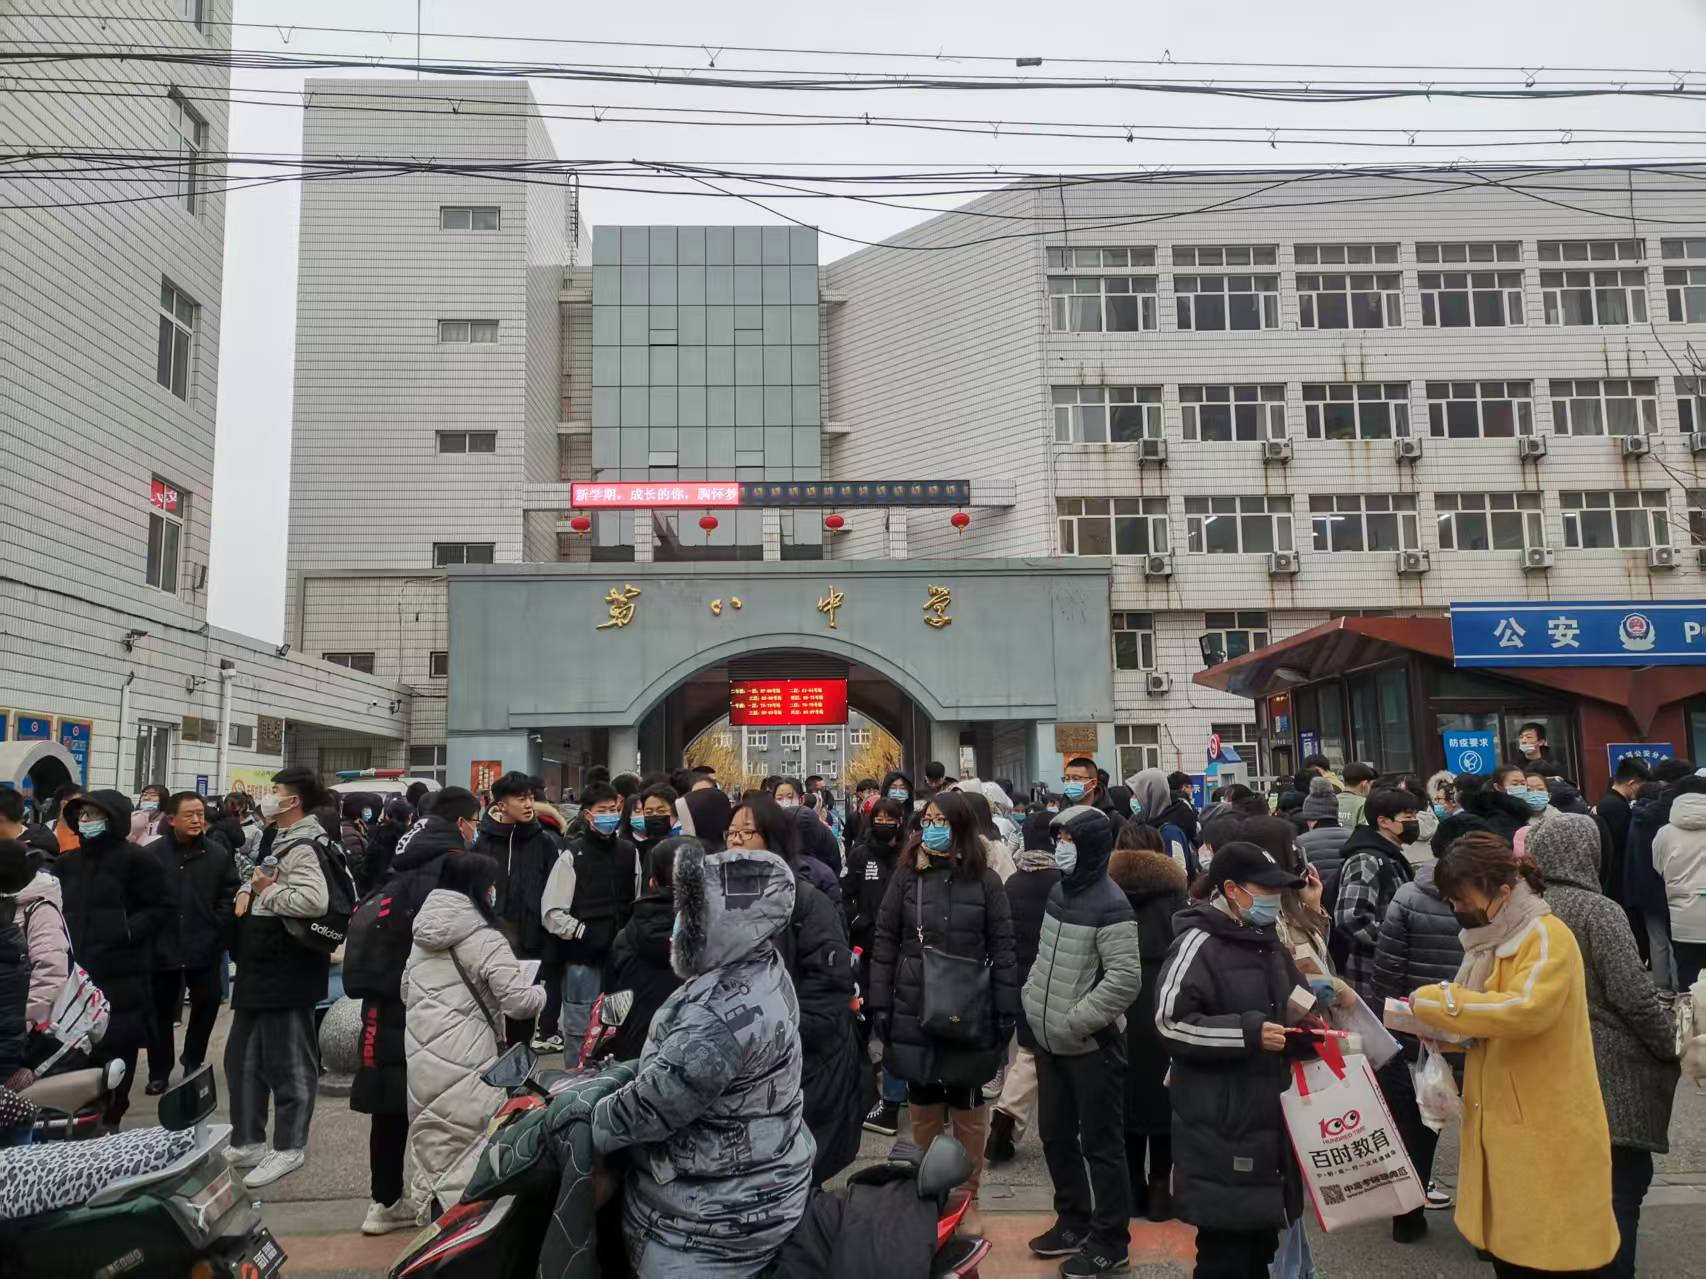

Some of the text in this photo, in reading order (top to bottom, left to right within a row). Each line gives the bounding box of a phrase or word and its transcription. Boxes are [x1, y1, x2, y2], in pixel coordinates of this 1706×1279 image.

[1493, 616, 1580, 648] 公安
[1683, 621, 1706, 644] P
[1449, 738, 1489, 748] 防疫要求
[311, 922, 343, 941] adidas
[1308, 1127, 1390, 1169] 百时教育
